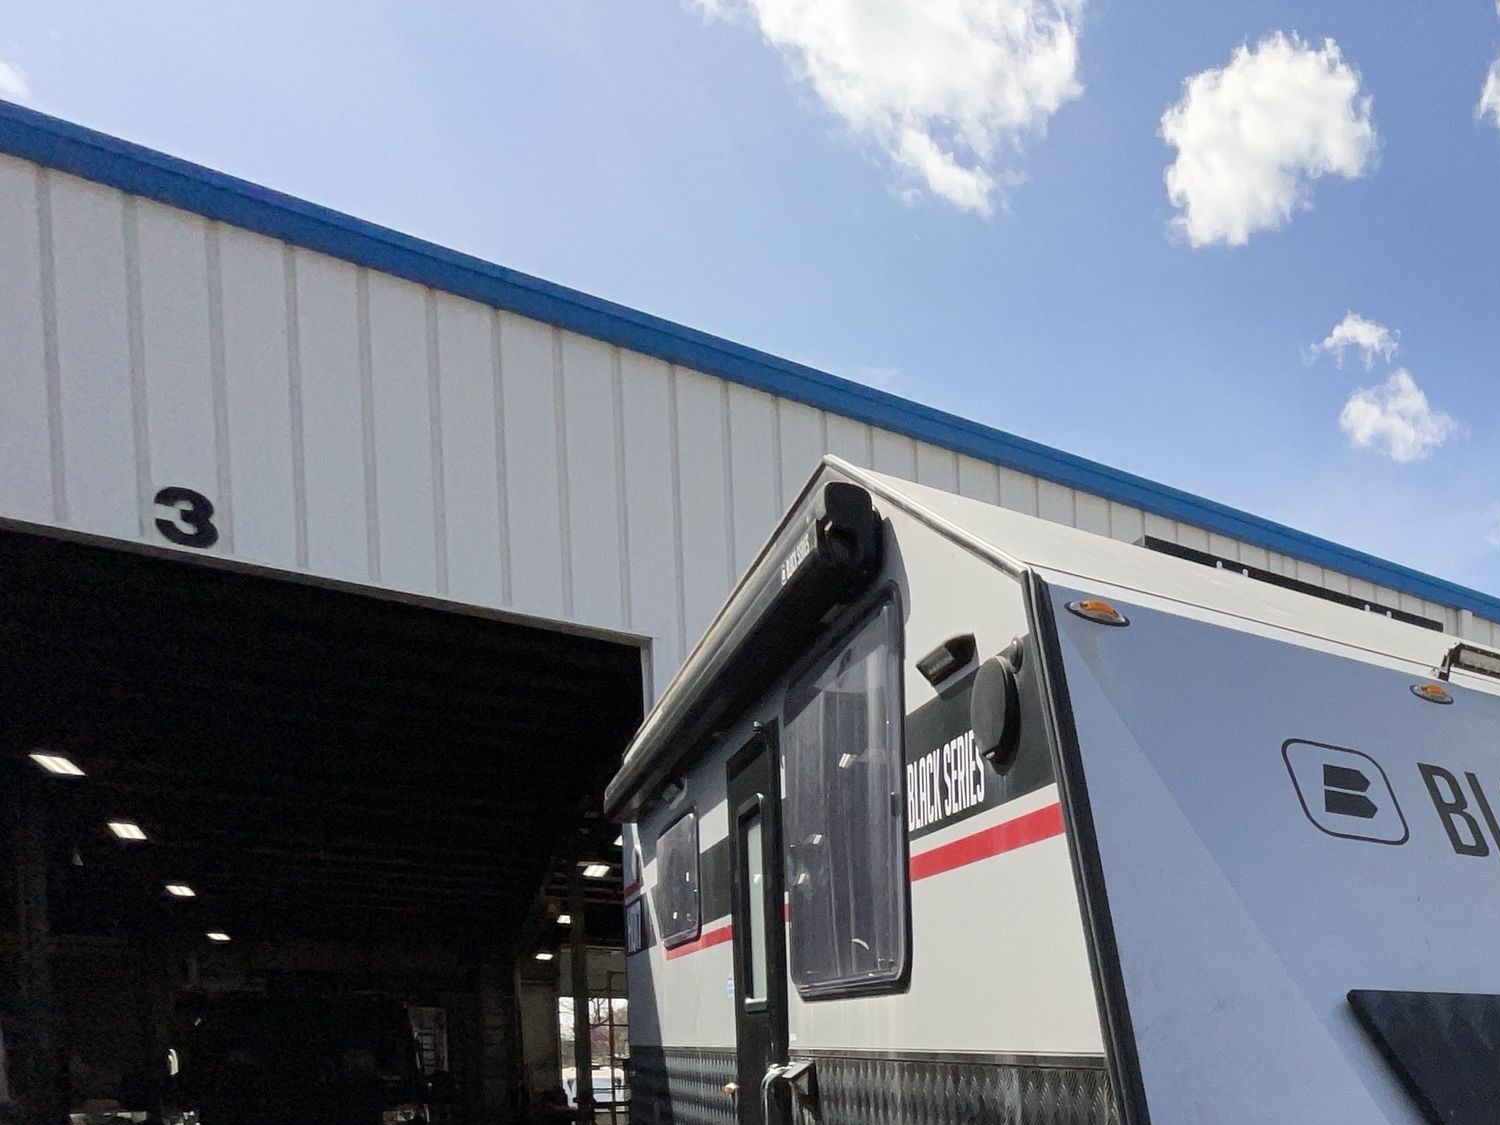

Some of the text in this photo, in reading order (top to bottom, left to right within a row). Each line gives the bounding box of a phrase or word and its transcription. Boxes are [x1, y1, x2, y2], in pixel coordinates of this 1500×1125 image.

[154, 486, 219, 549] 3
[906, 729, 985, 832] BLACK SERIES
